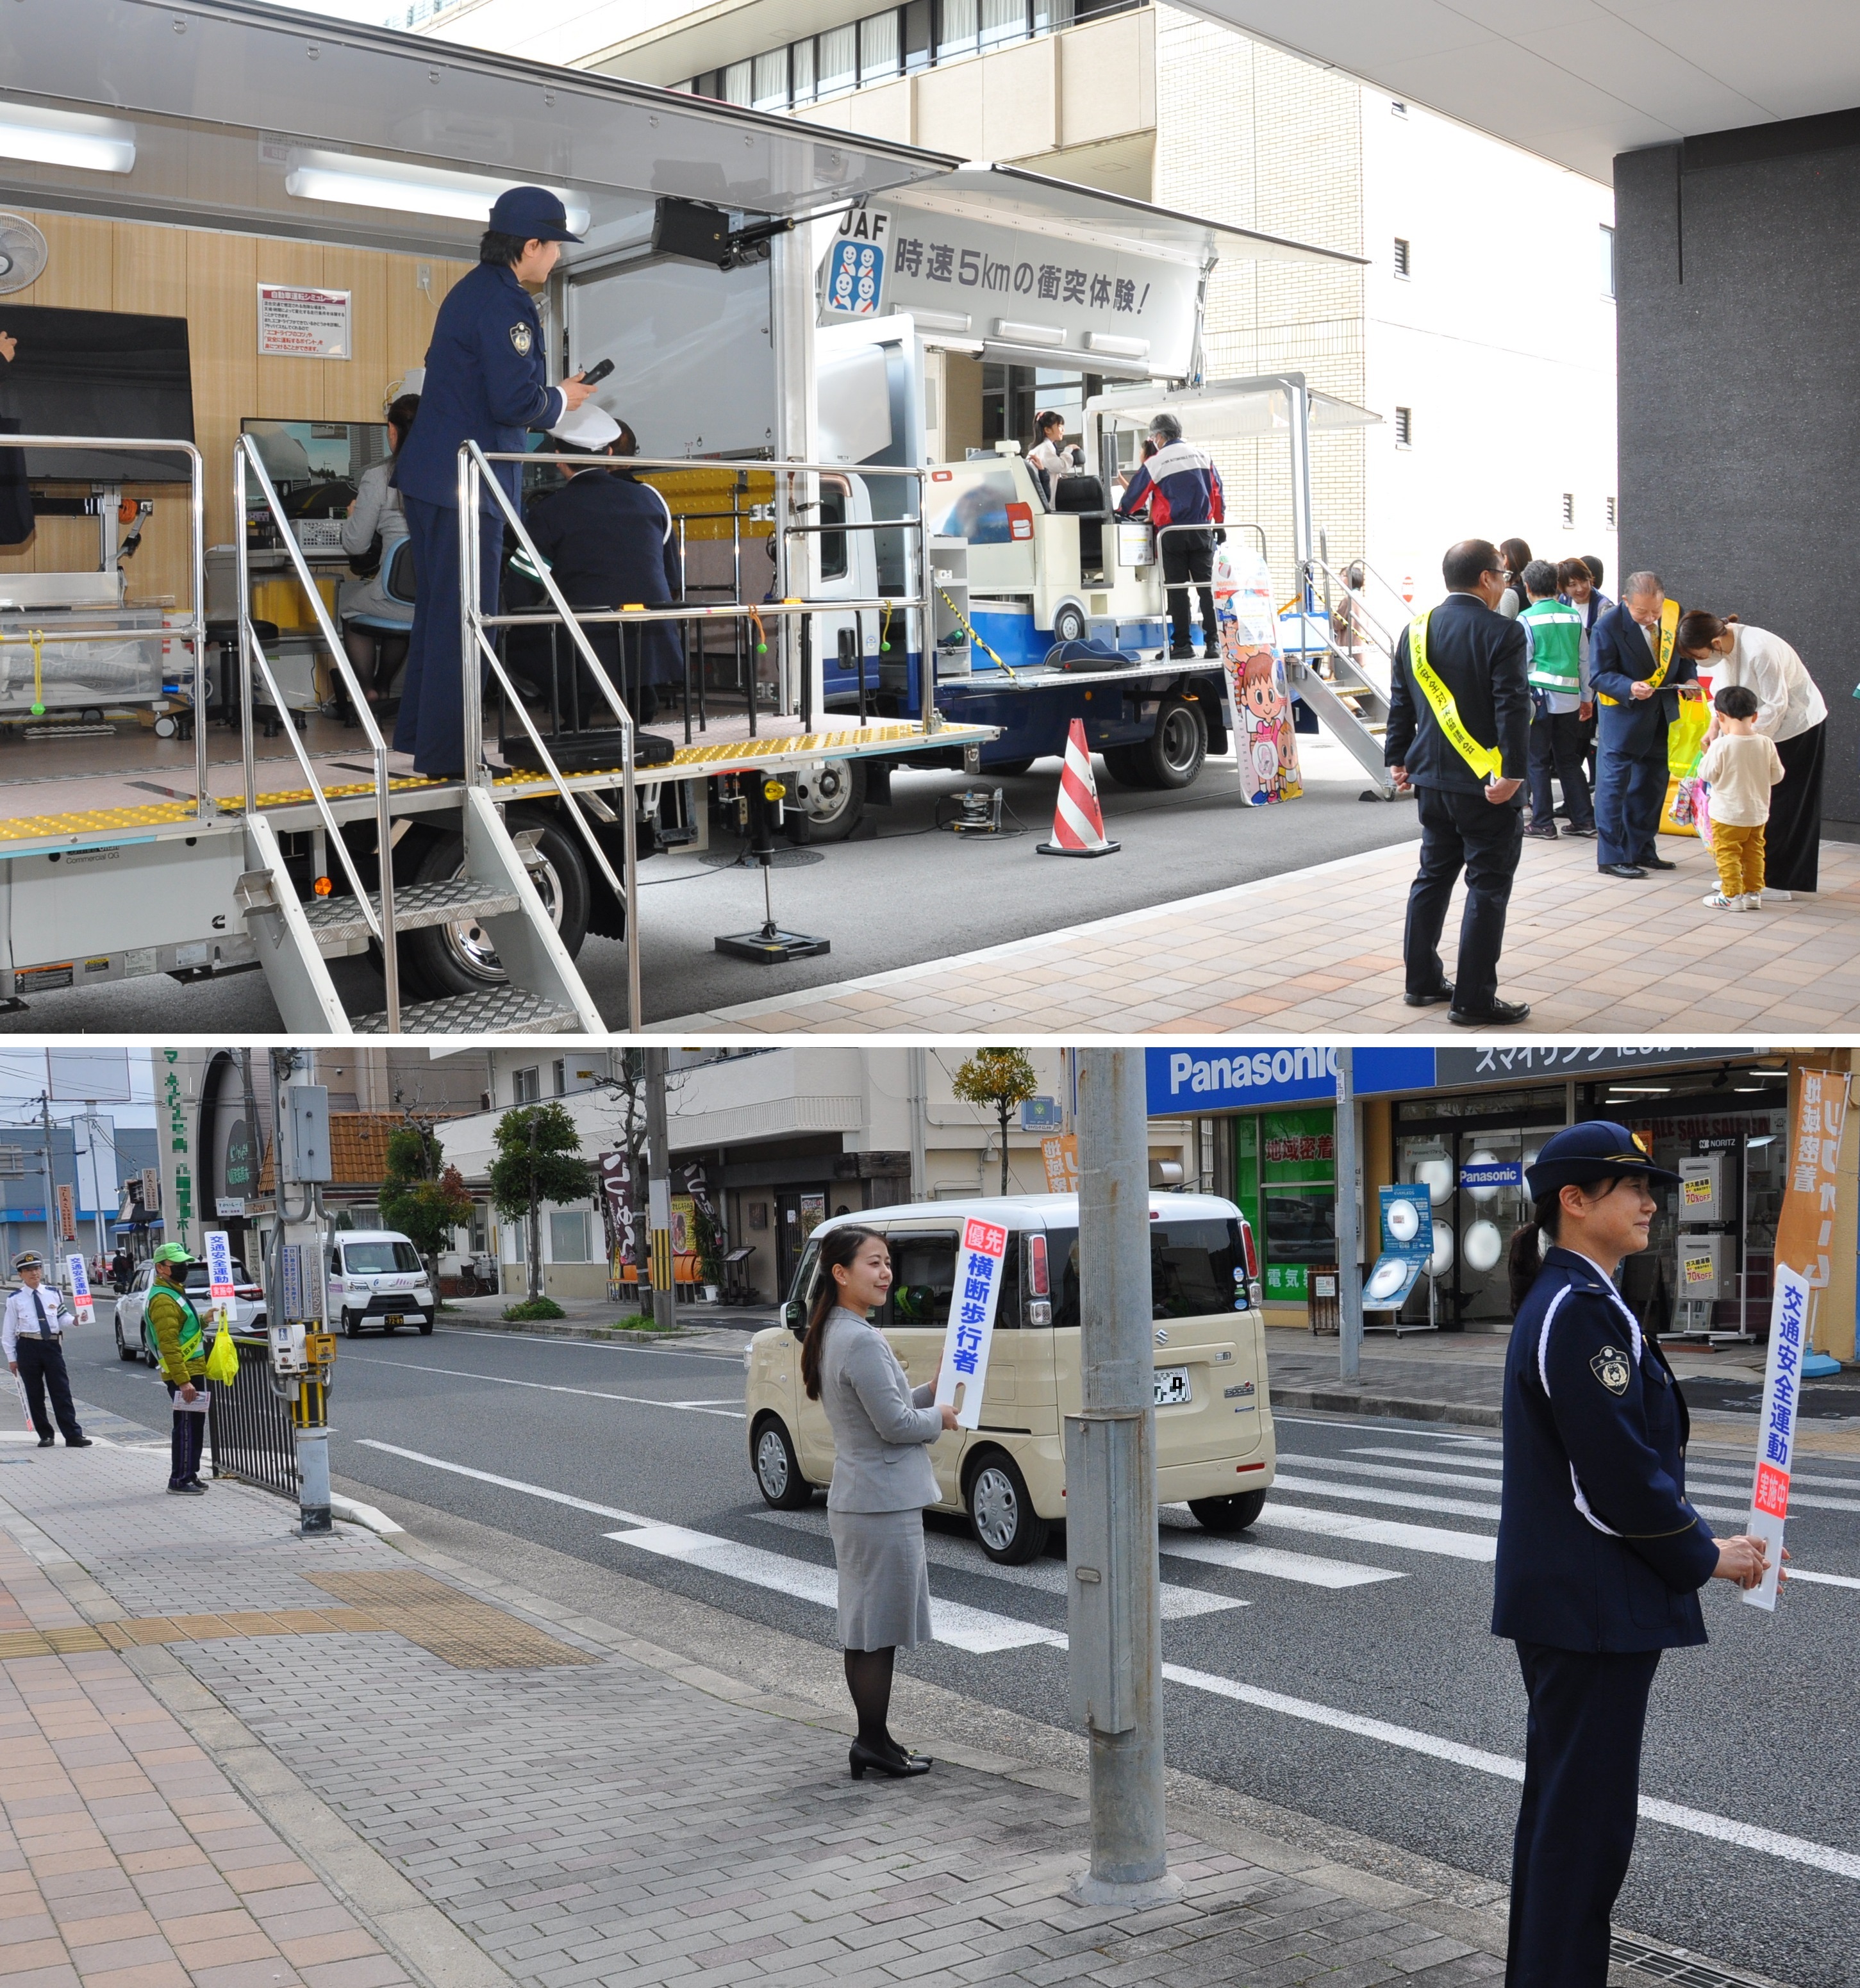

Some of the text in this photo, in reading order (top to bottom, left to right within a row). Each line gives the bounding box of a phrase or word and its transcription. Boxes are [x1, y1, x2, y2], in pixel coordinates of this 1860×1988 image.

[838, 210, 888, 242] JAF
[66, 853, 107, 864] Commercial
[1265, 1135, 1334, 1162] 地域密着
[1710, 1138, 1736, 1148] NORITZ
[1459, 1168, 1517, 1183] Panasonic
[1686, 1193, 1711, 1204] 70%OFF
[968, 1223, 1003, 1254] 優先
[210, 1236, 229, 1284] 交通安全運動
[70, 1257, 88, 1296] 交通安全運動
[212, 1286, 234, 1296] 実施中
[1686, 1271, 1713, 1282] 70%OFF
[952, 1253, 994, 1375] 横断歩行者
[1766, 1284, 1804, 1466] 交通安全運動
[1757, 1470, 1786, 1513] 実施中
